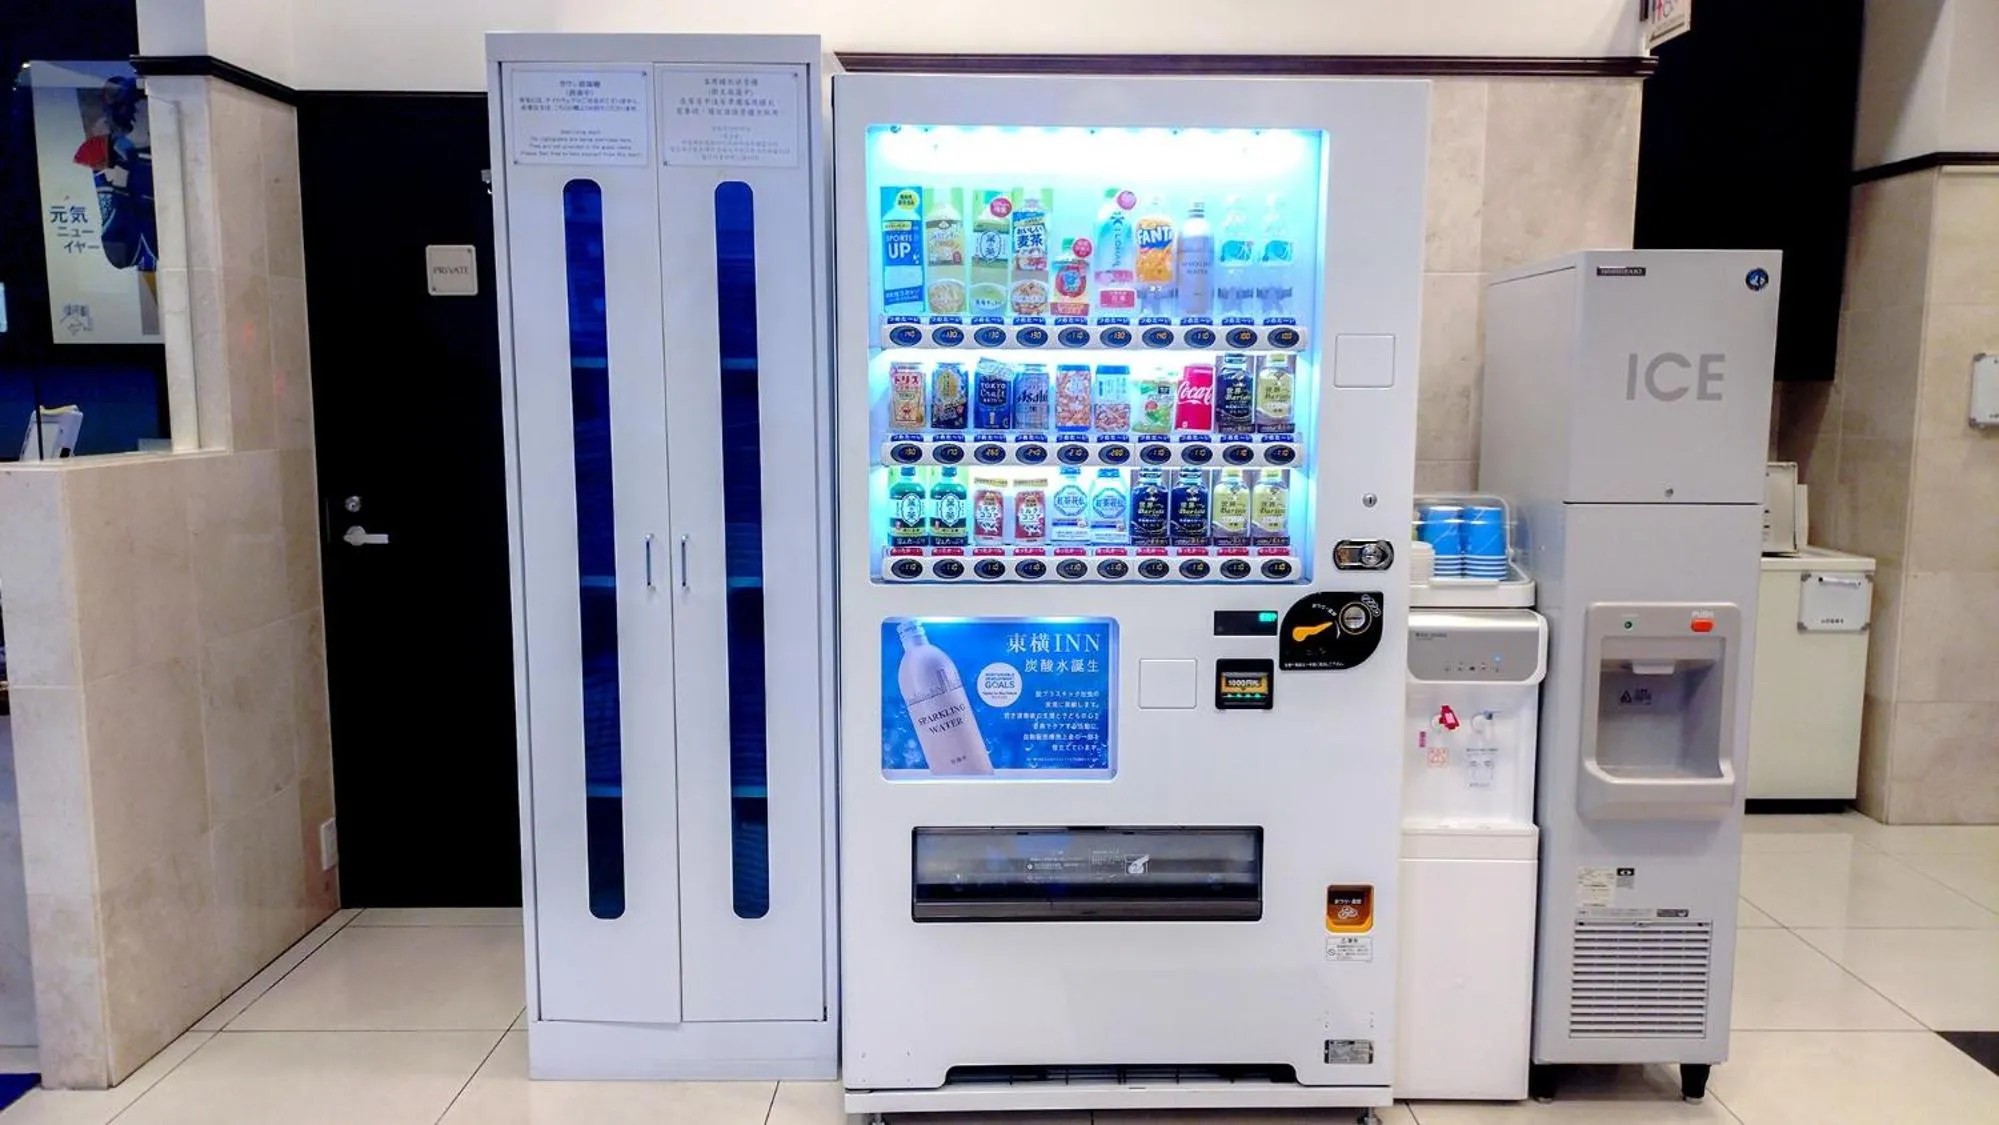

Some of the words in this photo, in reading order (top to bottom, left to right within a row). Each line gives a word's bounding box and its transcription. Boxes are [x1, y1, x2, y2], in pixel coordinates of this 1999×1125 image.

[50, 205, 88, 223] 元気
[57, 226, 94, 238] ニュー
[1017, 226, 1043, 234] おいしい
[64, 240, 100, 253] イヤー
[1017, 234, 1043, 249] 麦茶
[888, 242, 911, 259] UP
[433, 266, 469, 275] PRIVATE
[895, 375, 919, 385] トリス
[1626, 352, 1725, 402] ICE
[981, 382, 1006, 390] TOKYO
[1006, 632, 1101, 653] 東横INN
[1024, 659, 1100, 673] 炭酸水誕生
[984, 681, 1015, 689] GOALS
[918, 704, 966, 726] SPARKLING
[929, 717, 964, 735] WATER
